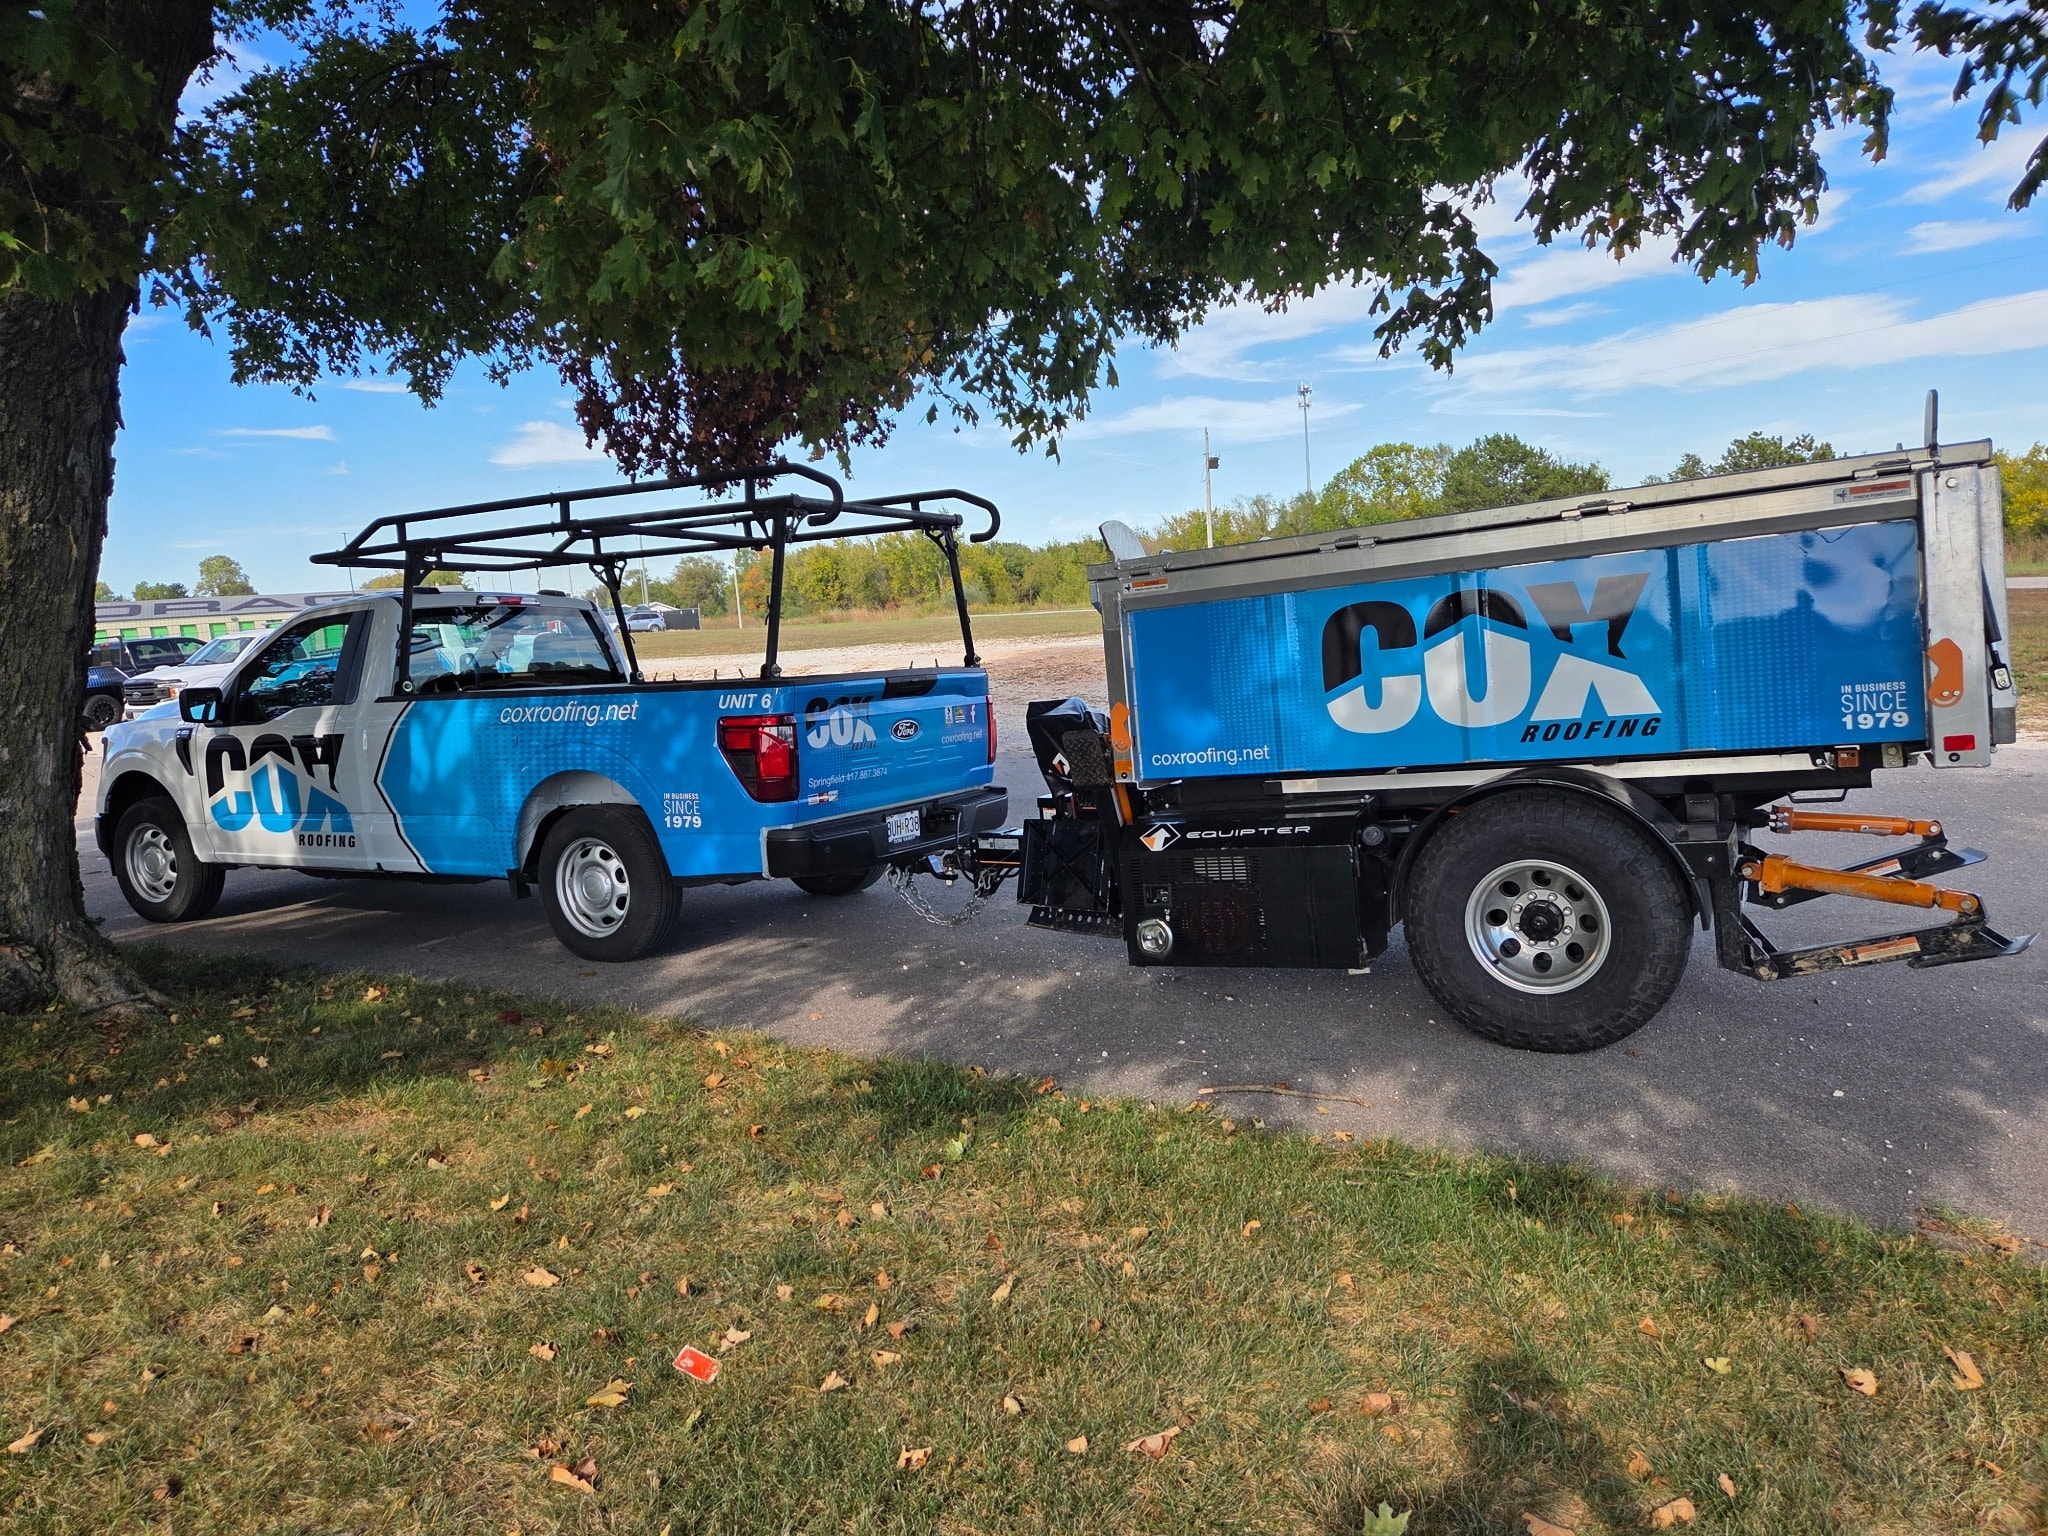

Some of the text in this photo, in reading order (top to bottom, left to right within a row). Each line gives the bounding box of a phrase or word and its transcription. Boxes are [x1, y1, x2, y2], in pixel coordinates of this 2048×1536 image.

[1321, 572, 1662, 734] COX
[1841, 681, 1906, 694] IN BUSINESS
[718, 693, 772, 709] UNIT 6
[1841, 691, 1908, 713] SINCE
[500, 700, 639, 727] coxroofing.net
[805, 695, 877, 749] COX
[1842, 711, 1909, 730] 1979
[941, 730, 983, 745] coxroofing.net
[1520, 717, 1662, 743] ROOFING
[1152, 744, 1270, 766] coxroofing.net
[205, 733, 354, 833] COX
[808, 767, 888, 789] Springfield 417.887.3874
[663, 792, 699, 800] IN BUSINESS
[663, 799, 701, 815] SINCE
[664, 815, 702, 828] 1979
[299, 834, 356, 848] ROOFING
[1186, 825, 1311, 839] EQUIPTER
